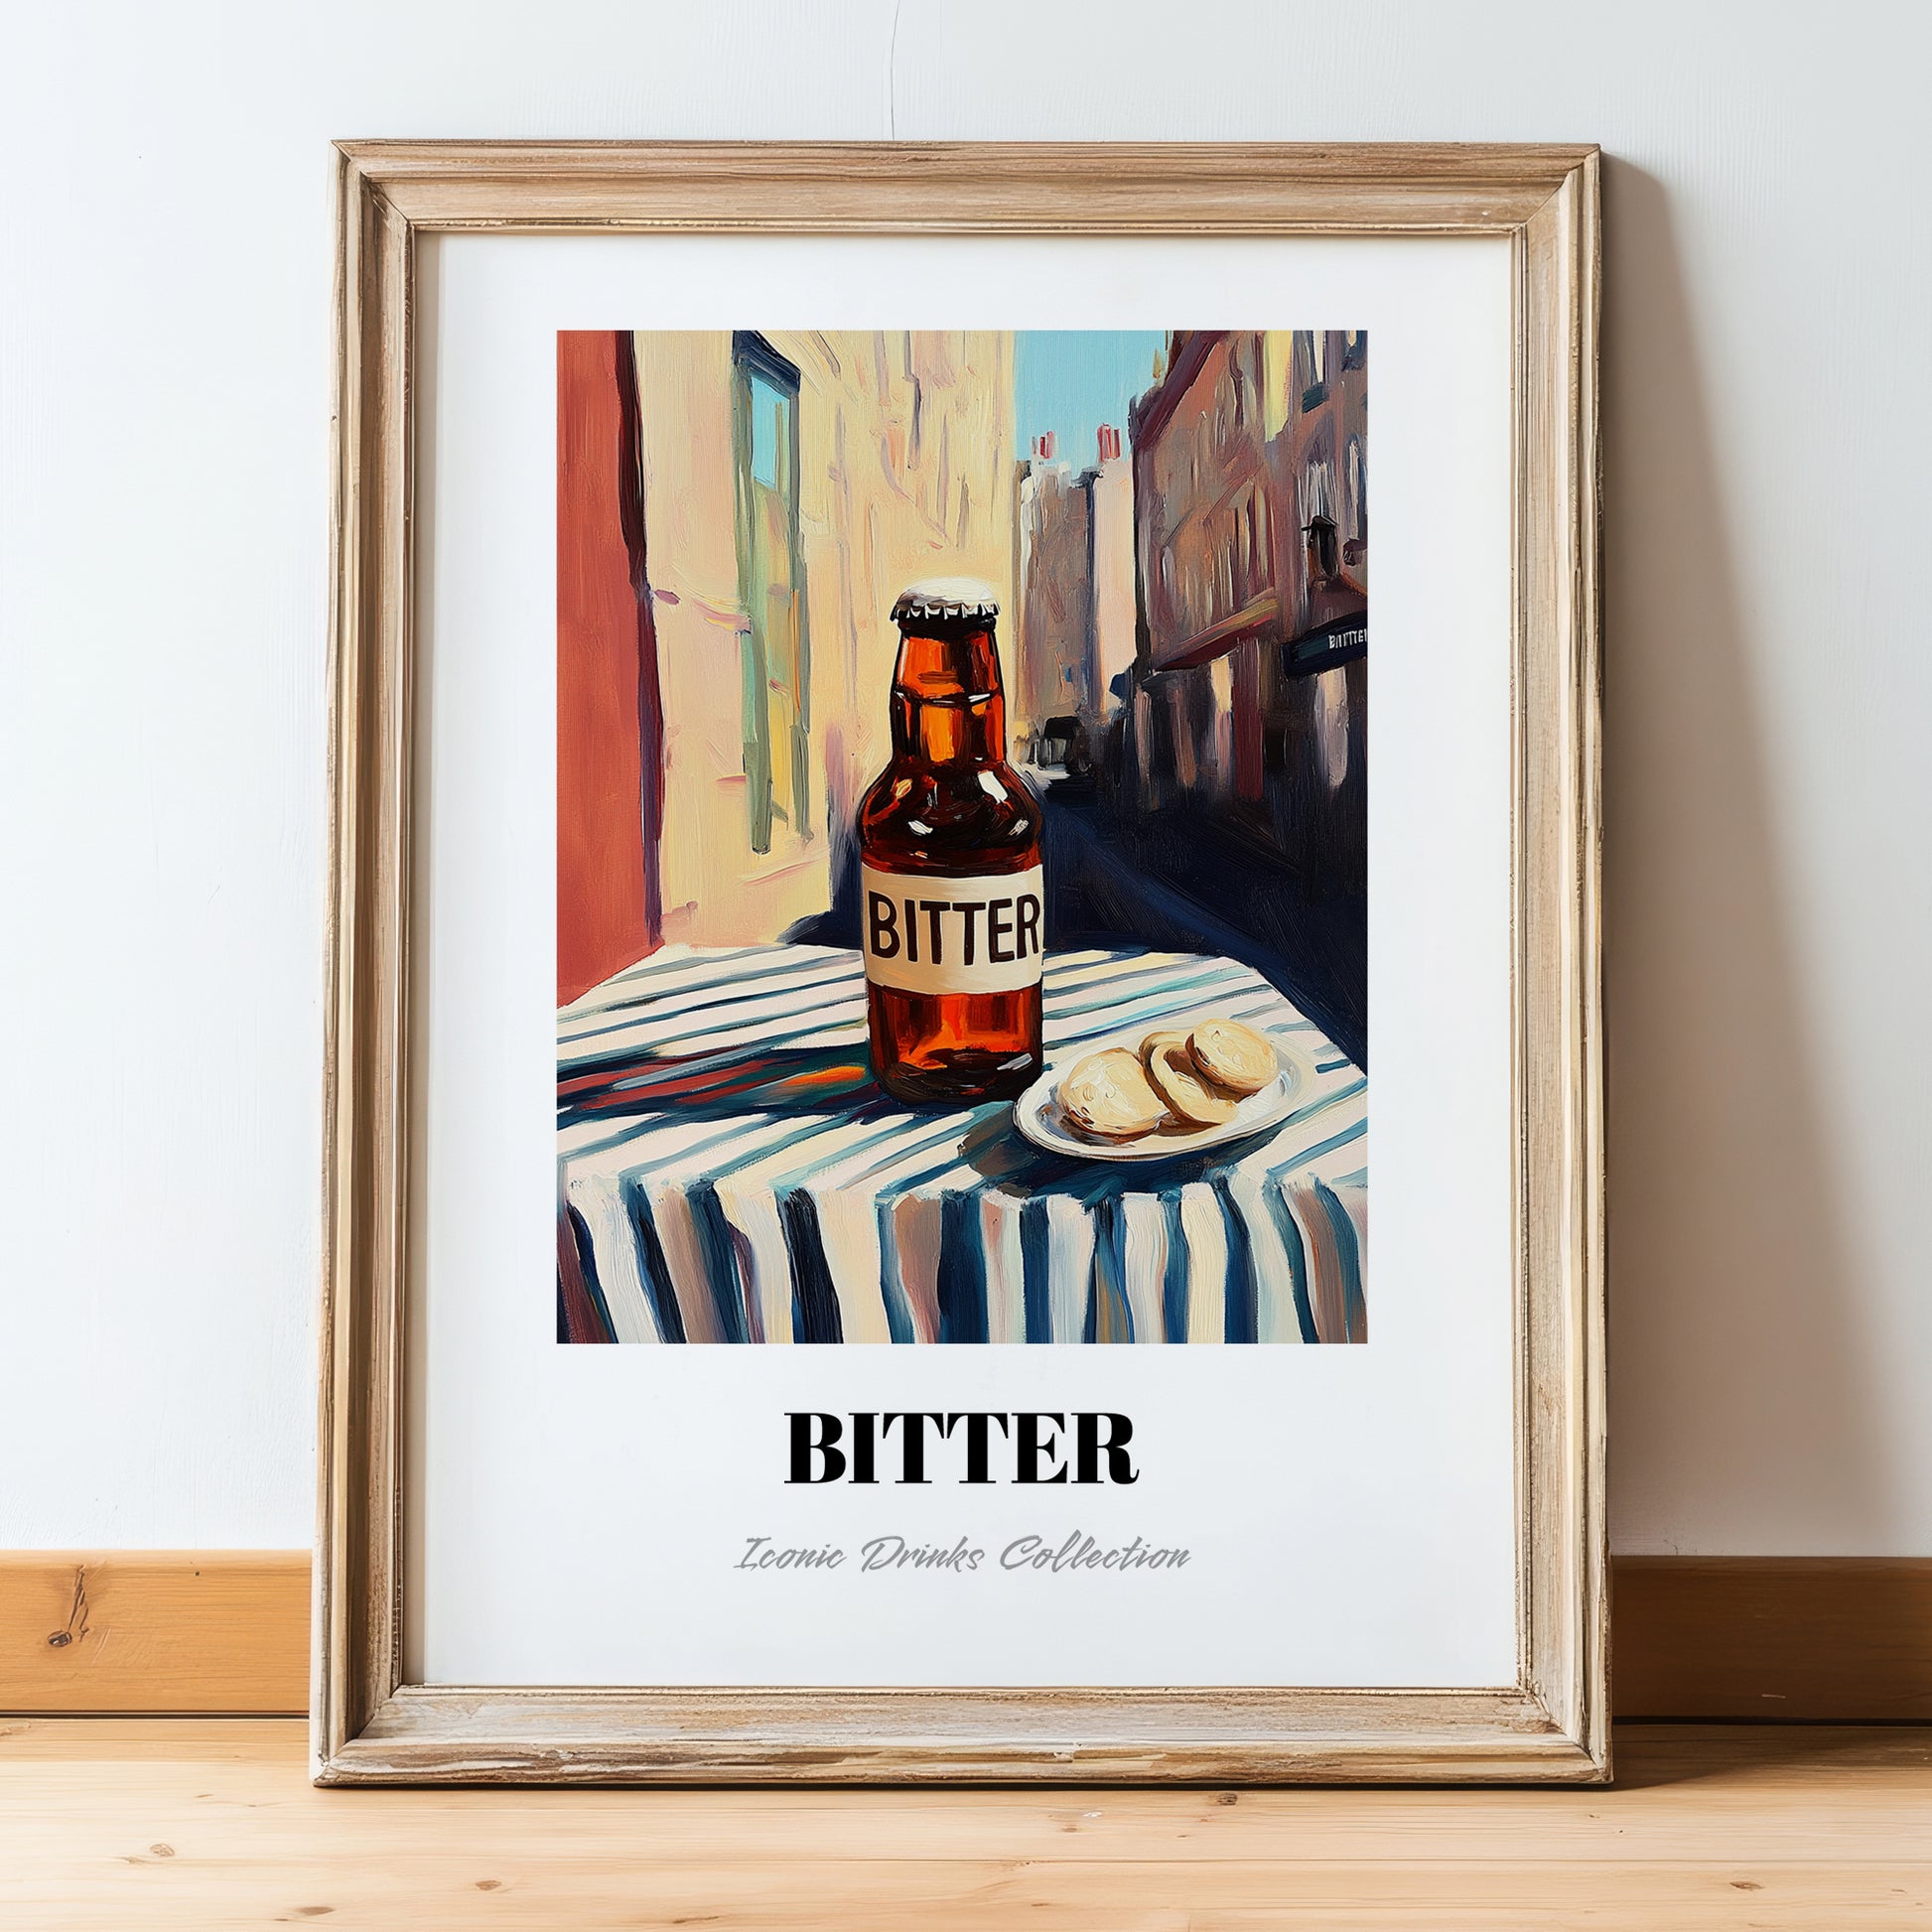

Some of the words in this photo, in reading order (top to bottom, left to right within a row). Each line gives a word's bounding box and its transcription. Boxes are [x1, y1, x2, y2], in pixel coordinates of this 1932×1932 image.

[869, 890, 1040, 966] BITTER
[783, 1412, 1140, 1485] BITTER
[733, 1536, 848, 1572] Iconic
[860, 1535, 986, 1574] Drinks
[999, 1528, 1192, 1574] Collection
